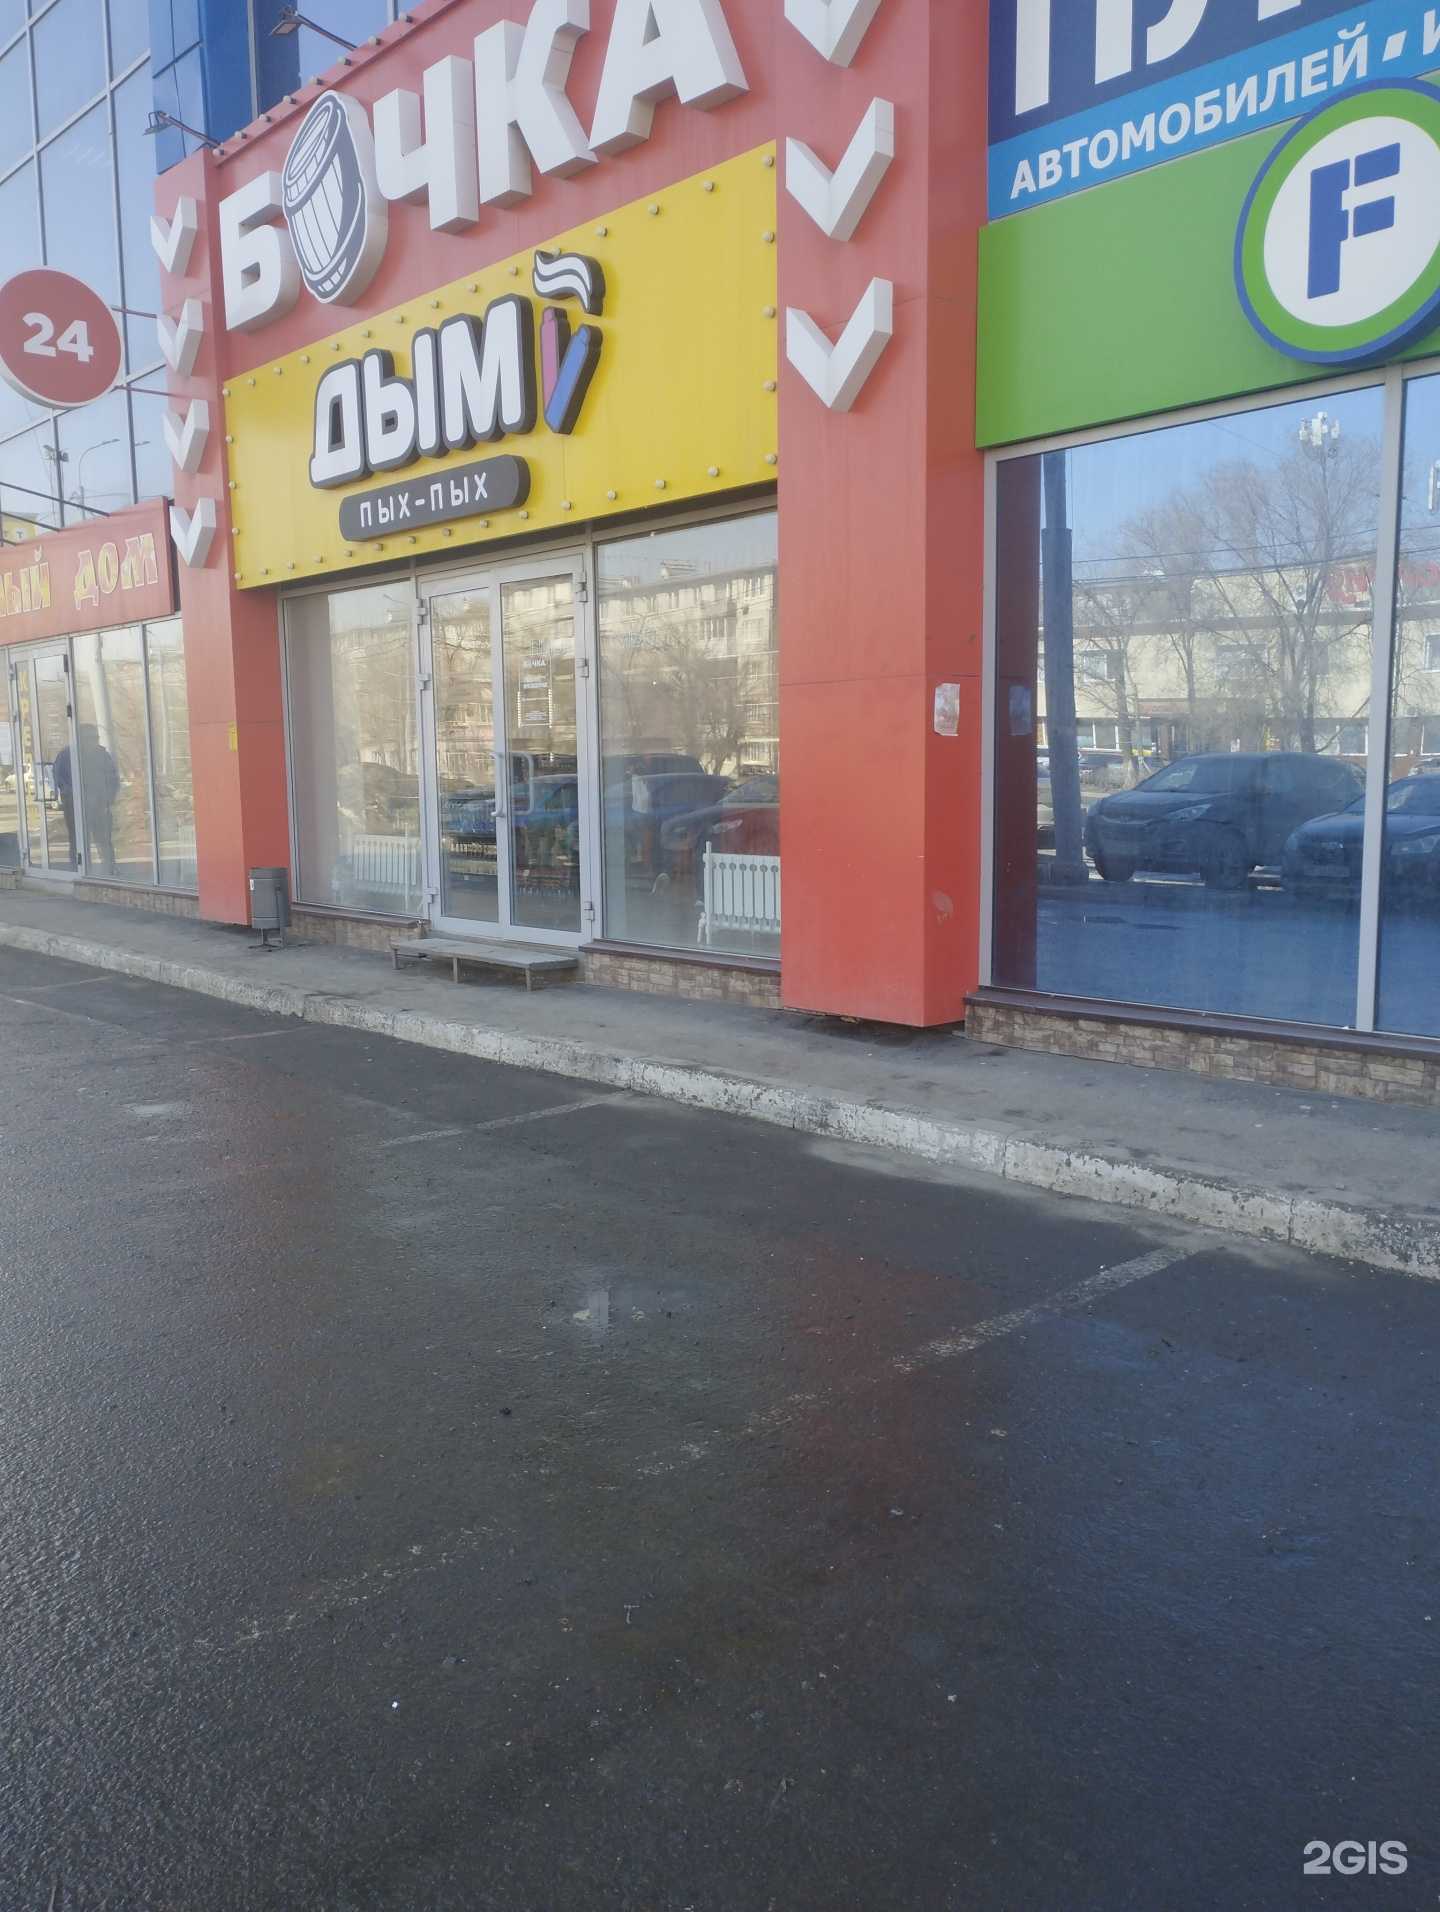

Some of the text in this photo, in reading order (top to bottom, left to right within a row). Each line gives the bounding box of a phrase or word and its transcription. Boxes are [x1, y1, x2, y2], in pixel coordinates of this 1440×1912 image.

[1010, 21, 1368, 199] АВТОМОБИЛЕЙ
[22, 312, 94, 363] 24
[309, 293, 537, 489] ДЫМ
[360, 471, 488, 527] ПЫХ-ПЫХ
[0, 533, 158, 618] ЫЙ ДОМ
